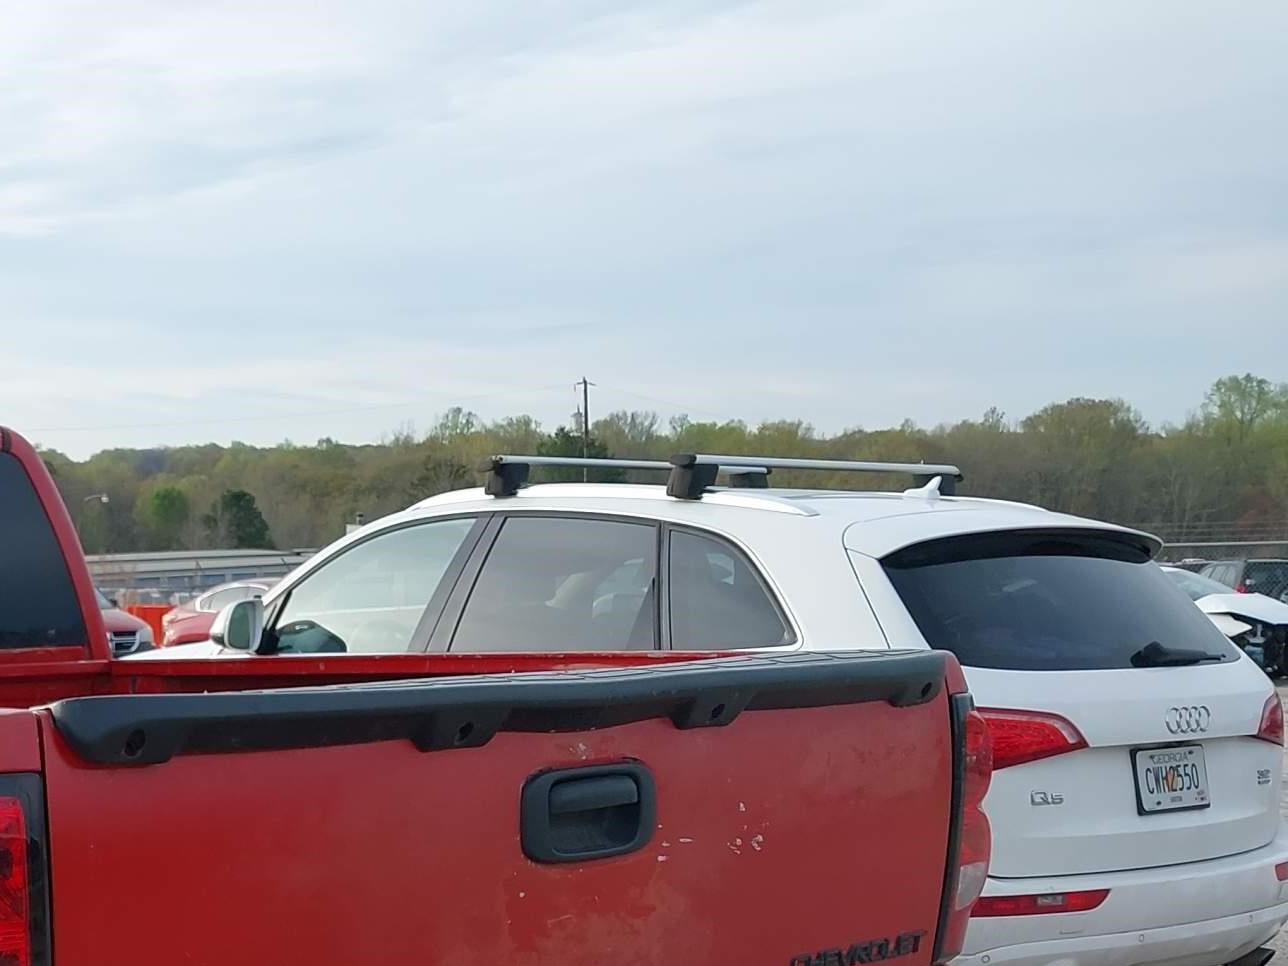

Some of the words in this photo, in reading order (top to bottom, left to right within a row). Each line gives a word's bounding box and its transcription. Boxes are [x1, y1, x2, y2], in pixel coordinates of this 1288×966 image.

[1151, 751, 1189, 765] GEORGIA
[1145, 763, 1200, 794] CWH2550
[1030, 790, 1065, 806] Q5
